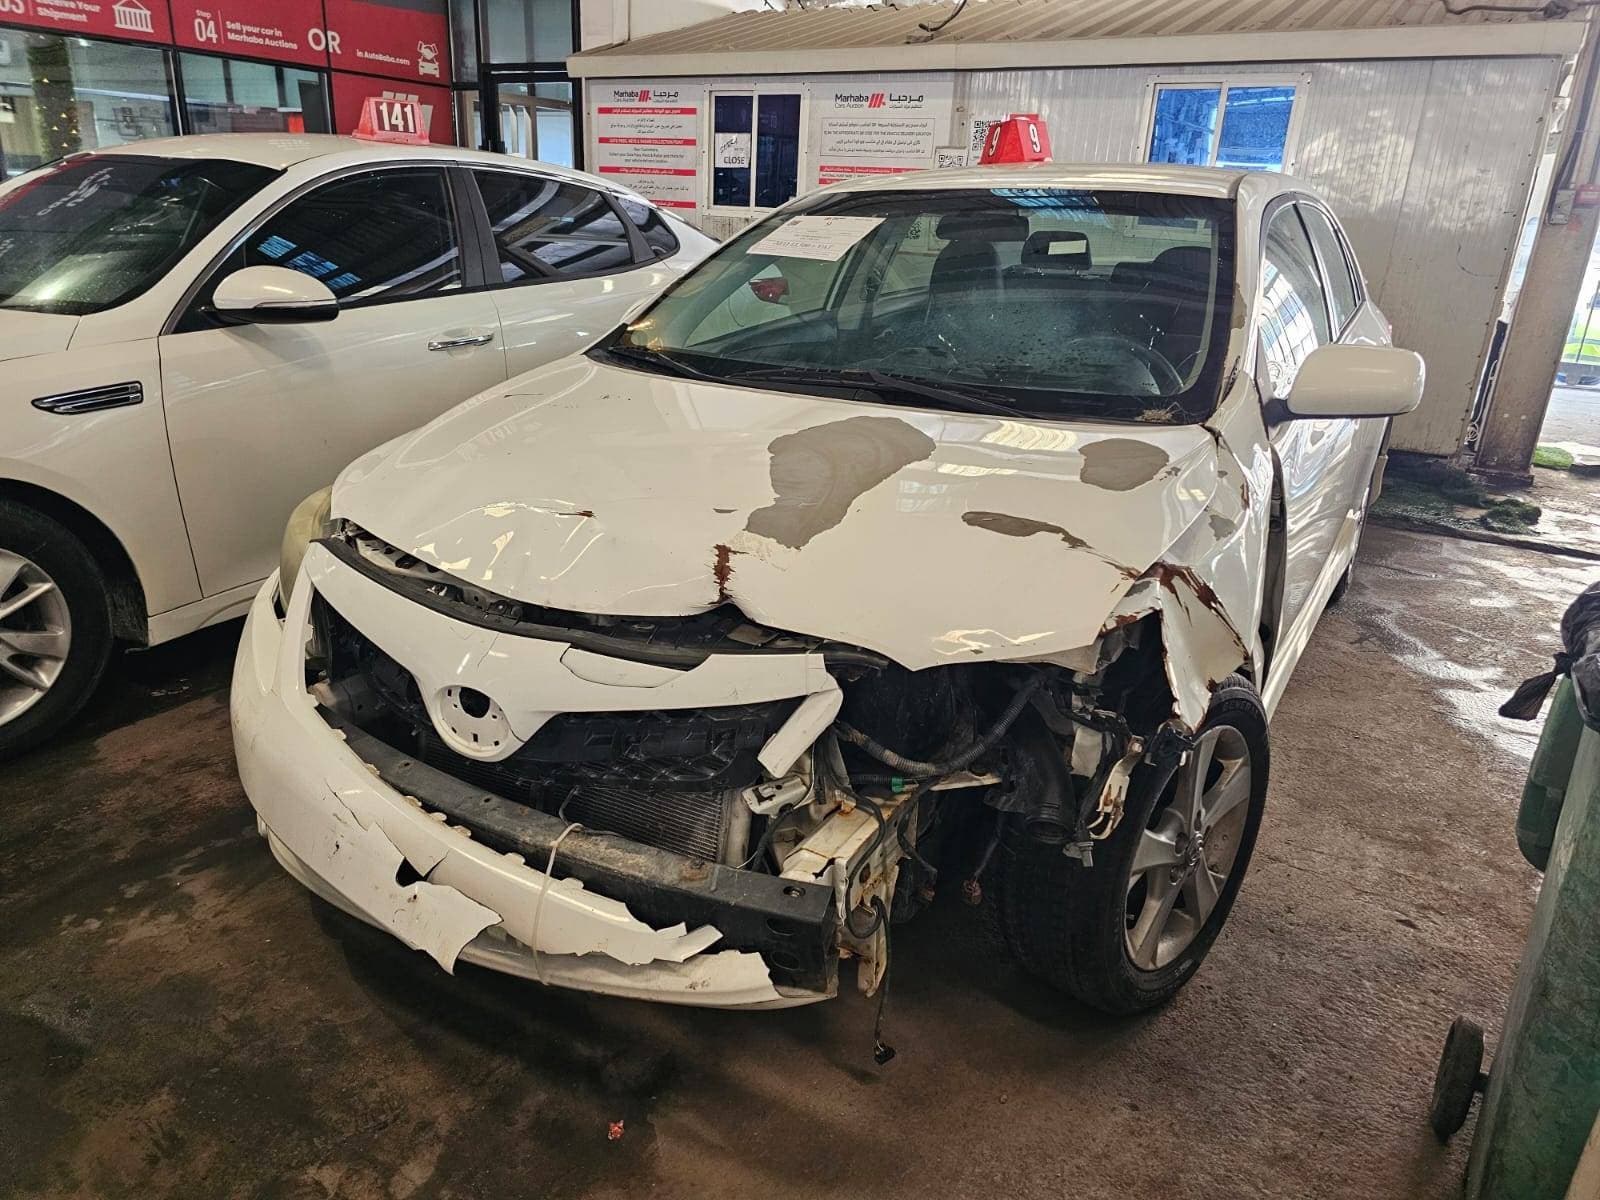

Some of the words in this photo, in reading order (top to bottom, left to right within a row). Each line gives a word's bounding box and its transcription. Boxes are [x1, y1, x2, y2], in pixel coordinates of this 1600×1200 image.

[36, 7, 88, 22] Shipment
[194, 18, 218, 44] 04
[226, 21, 242, 30] Sell
[241, 23, 260, 34] your
[260, 28, 274, 37] car
[274, 28, 283, 37] in
[226, 32, 264, 45] Marhaba
[264, 37, 299, 50] Auctions
[307, 27, 342, 55] OR
[613, 90, 639, 98] Marhaba
[834, 93, 869, 102] Marhaba
[380, 102, 415, 133] 141
[988, 126, 1001, 157] 9
[1028, 123, 1041, 153] 9
[723, 156, 745, 165] CLOSE
